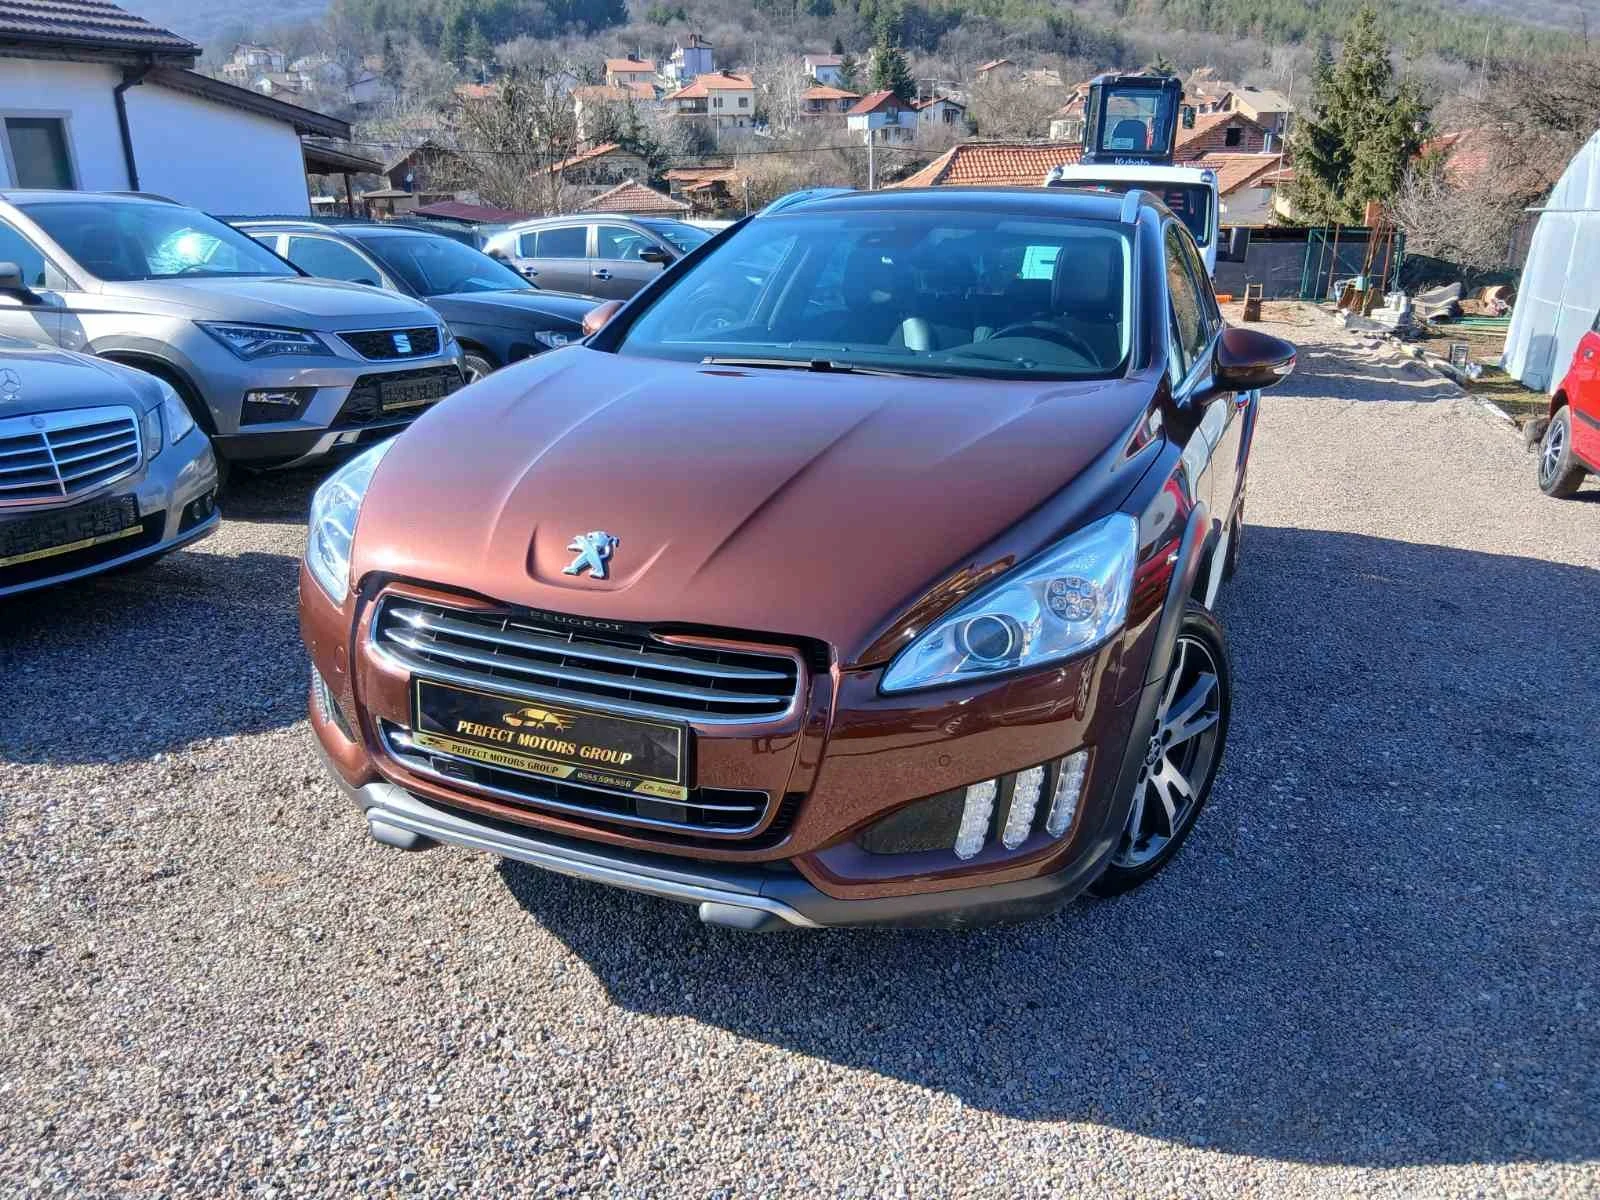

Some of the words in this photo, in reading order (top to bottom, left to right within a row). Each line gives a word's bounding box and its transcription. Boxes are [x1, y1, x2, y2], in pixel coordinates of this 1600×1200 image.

[451, 744, 488, 759] PERFECT
[489, 750, 526, 768] MOTORS
[527, 761, 559, 774] GROUP
[456, 720, 517, 743] PERFECT
[517, 733, 577, 756] MOTORS
[580, 745, 632, 765] GROUP
